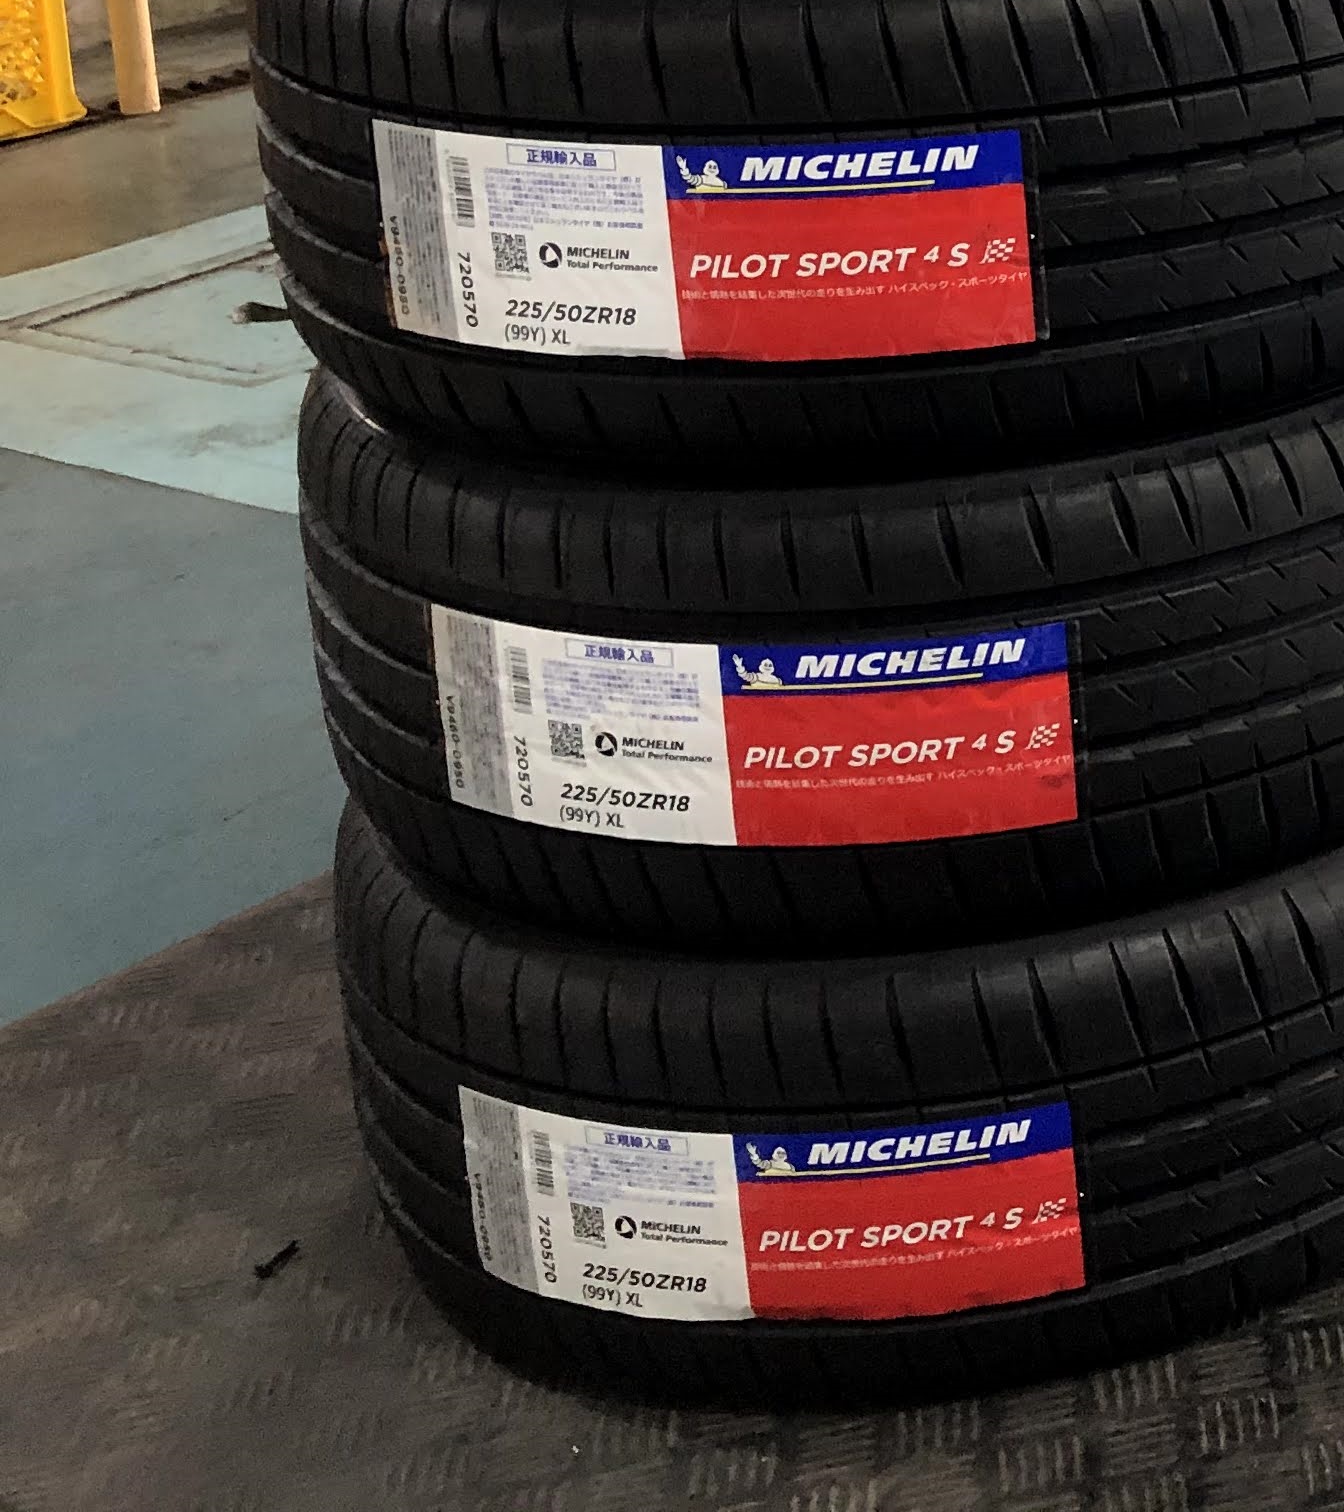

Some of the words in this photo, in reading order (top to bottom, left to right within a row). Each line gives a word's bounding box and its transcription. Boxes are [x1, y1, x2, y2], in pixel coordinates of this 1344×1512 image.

[526, 149, 596, 167] 正規輸入品
[740, 146, 978, 181] MICHELIN
[567, 246, 629, 261] MICHELIN
[689, 252, 791, 278] PILOT
[796, 248, 916, 277] SPORT
[924, 247, 940, 263] 4
[948, 243, 970, 266] S
[567, 260, 590, 270] Total
[592, 261, 658, 273] Performance
[456, 251, 477, 328] 720570
[888, 271, 1028, 294] ハイスペック・スポーツタイヤ
[506, 300, 636, 326] 225/50ZR18
[504, 324, 547, 345] (99Y)
[552, 327, 571, 345] XL
[583, 645, 655, 664] 正規輸入品
[795, 639, 1025, 678] MICHELIN
[621, 736, 685, 751] MICHELIN
[744, 744, 842, 768] PILOT
[847, 737, 965, 766] SPORT
[972, 736, 987, 751] 4
[995, 730, 1016, 754] S
[621, 749, 646, 759] Total
[647, 751, 713, 764] Performance
[514, 736, 534, 806] 720570
[560, 784, 690, 811] 225/50ZR18
[559, 806, 601, 827] (99Y)
[606, 810, 624, 828] XL
[603, 1133, 671, 1152] 正規輸入品
[807, 1119, 1032, 1165] MICHELIN
[641, 1220, 701, 1235] MICHELIN
[759, 1228, 855, 1251] PILOT
[860, 1216, 974, 1247] SPORT
[980, 1215, 996, 1229] 4
[1002, 1207, 1024, 1229] S
[537, 1216, 556, 1284] 720570
[641, 1234, 664, 1243] Total
[665, 1235, 729, 1247] Performance
[583, 1263, 707, 1293] 225/50ZR18
[583, 1285, 622, 1305] (99Y)
[626, 1290, 643, 1309] XL
